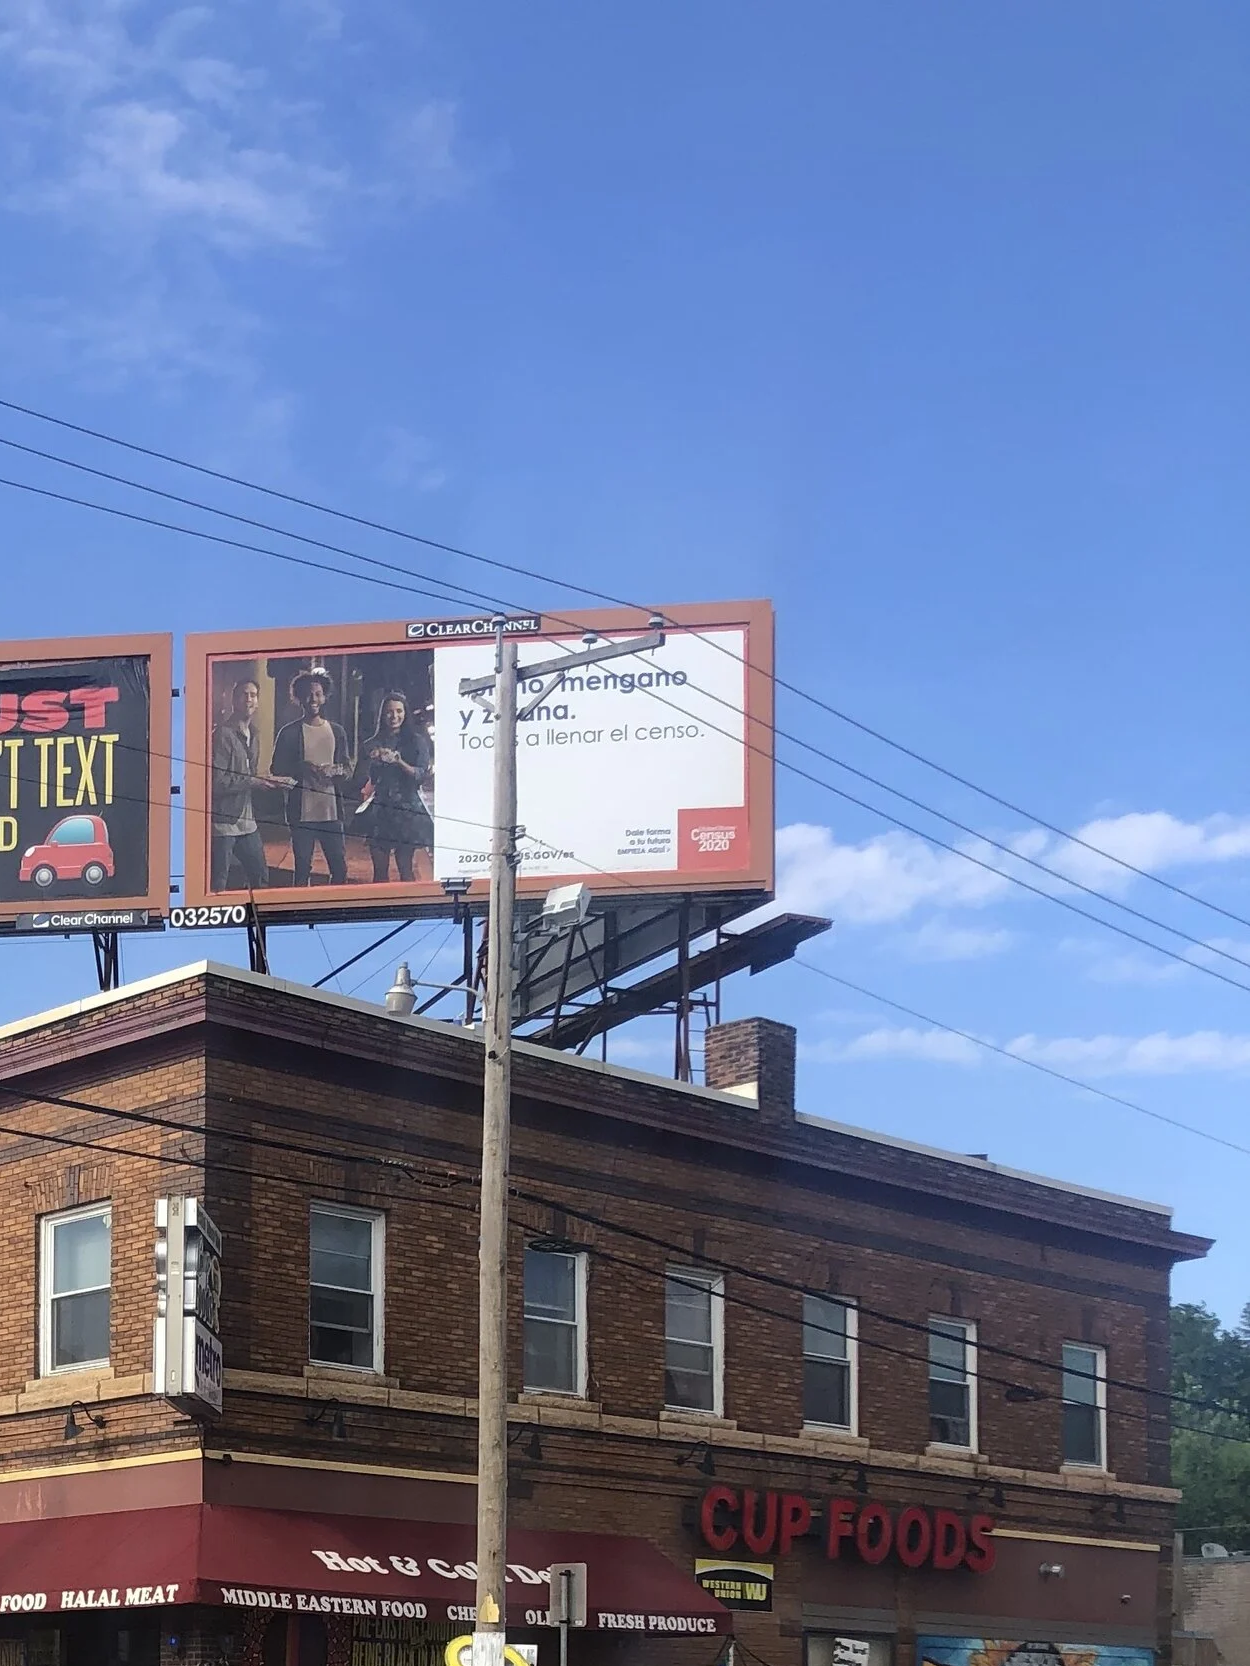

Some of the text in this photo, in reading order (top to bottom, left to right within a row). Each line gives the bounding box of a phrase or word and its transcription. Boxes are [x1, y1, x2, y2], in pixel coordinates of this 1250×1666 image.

[561, 669, 688, 694] mengano
[459, 710, 473, 729] y
[459, 723, 705, 750] Tods a llenar el censo.
[35, 733, 119, 808] TEXT
[691, 829, 736, 840] Census
[698, 840, 730, 852] 2020
[51, 911, 134, 928] Clear Channel
[170, 906, 246, 927] 032570
[701, 1486, 997, 1574] CUP FOODS
[312, 1550, 389, 1574] Hot
[389, 1555, 421, 1576] &
[702, 1580, 742, 1590] WESTERN
[714, 1589, 742, 1599] UNION
[745, 1583, 767, 1601] WU
[0, 1593, 47, 1613] FOOD
[60, 1584, 179, 1609] HALAL MEAT
[221, 1588, 292, 1610] MIDDLE
[297, 1594, 377, 1616] EASTERN
[382, 1600, 427, 1619] FOOD
[598, 1612, 645, 1629] FRESH
[649, 1615, 716, 1632] PRODUCE
